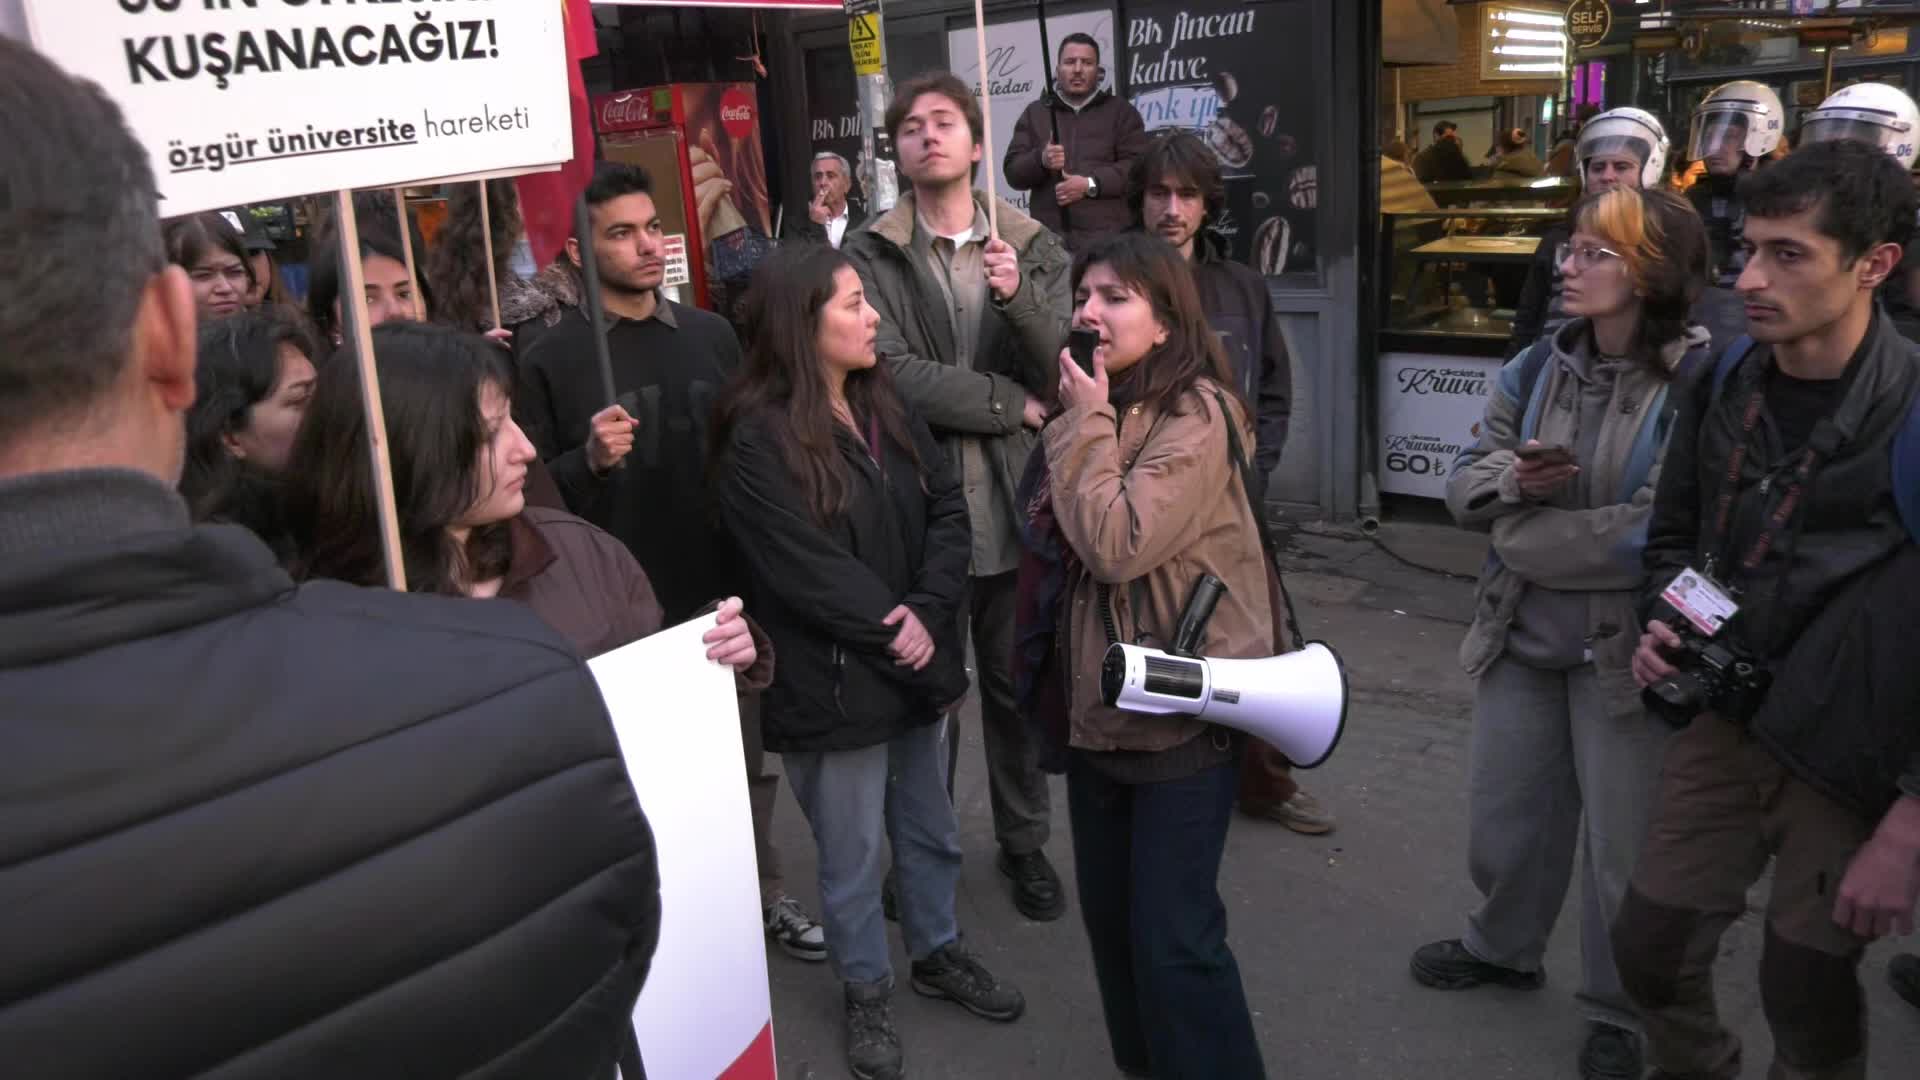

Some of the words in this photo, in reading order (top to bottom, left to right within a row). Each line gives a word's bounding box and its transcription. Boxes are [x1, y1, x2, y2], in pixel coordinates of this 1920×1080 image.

[1127, 17, 1163, 47] Bir
[1170, 9, 1255, 49] fincan
[1572, 10, 1604, 24] SELF
[122, 11, 500, 90] KUŞANACAĞIZ!
[168, 133, 257, 172] özgür
[268, 117, 417, 155] üniversite
[424, 103, 530, 137] hareketi
[1767, 119, 1779, 130] 06
[1896, 143, 1912, 157] 06
[1397, 367, 1488, 396] Kruva
